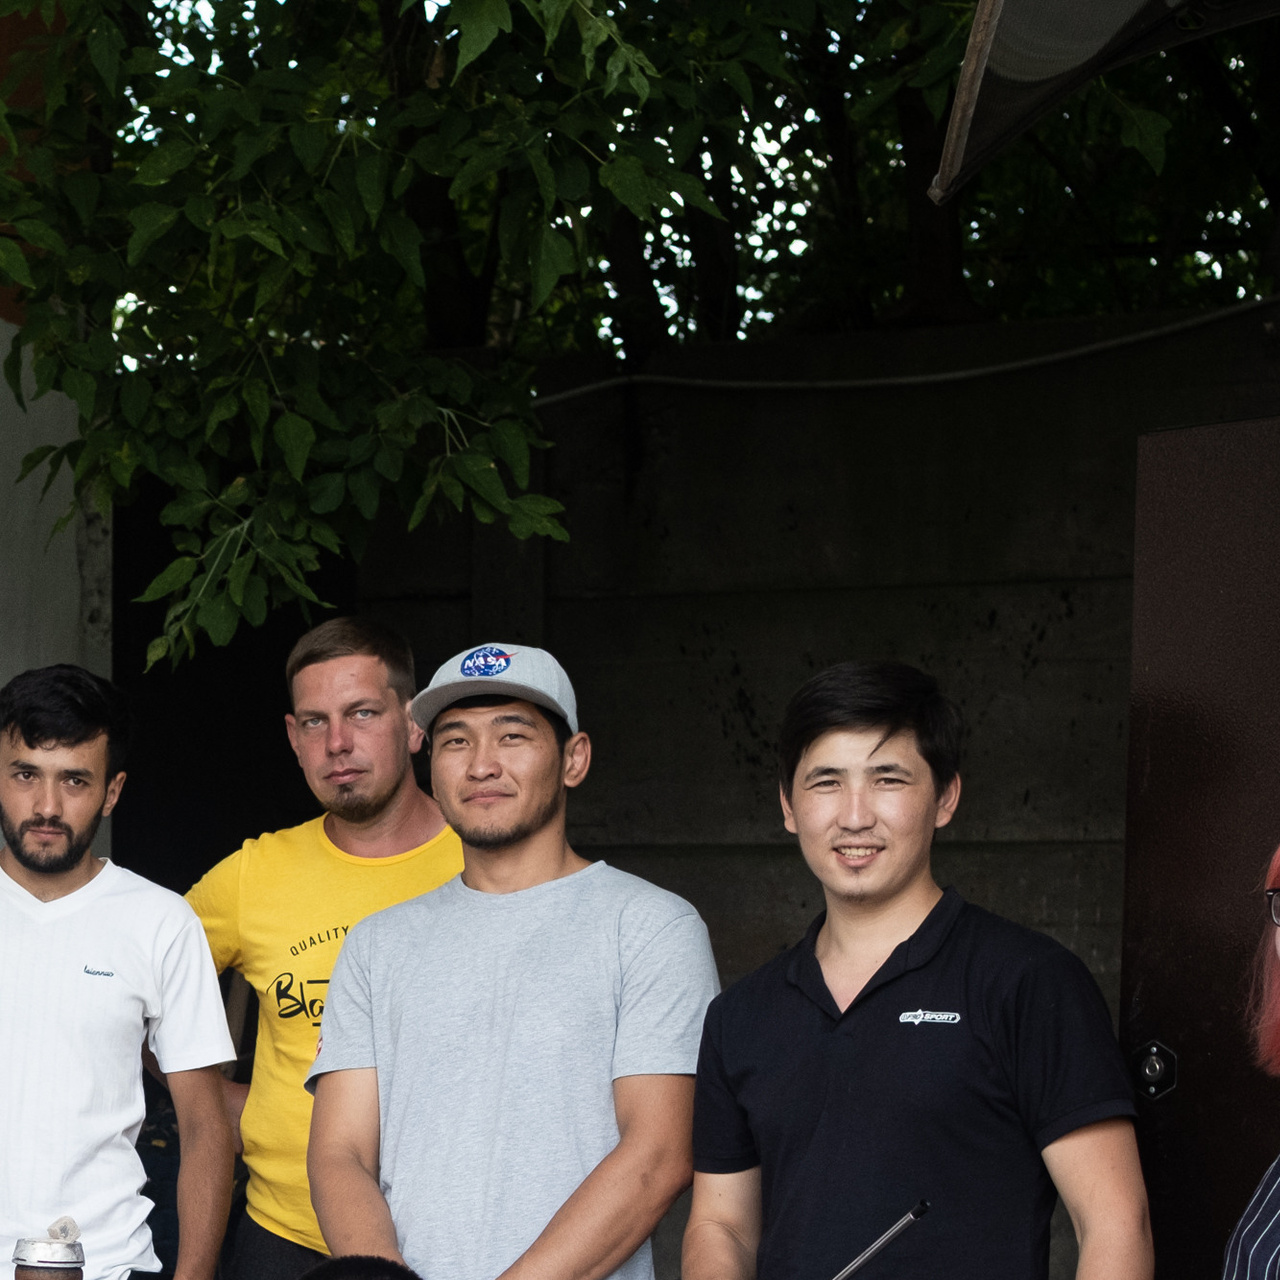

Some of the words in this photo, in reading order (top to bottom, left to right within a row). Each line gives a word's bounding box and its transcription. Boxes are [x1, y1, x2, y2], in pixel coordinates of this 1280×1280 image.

[464, 656, 507, 669] NASA
[289, 925, 350, 957] QUALITY
[266, 972, 325, 1019] Bla
[923, 1013, 956, 1021] SPORT
